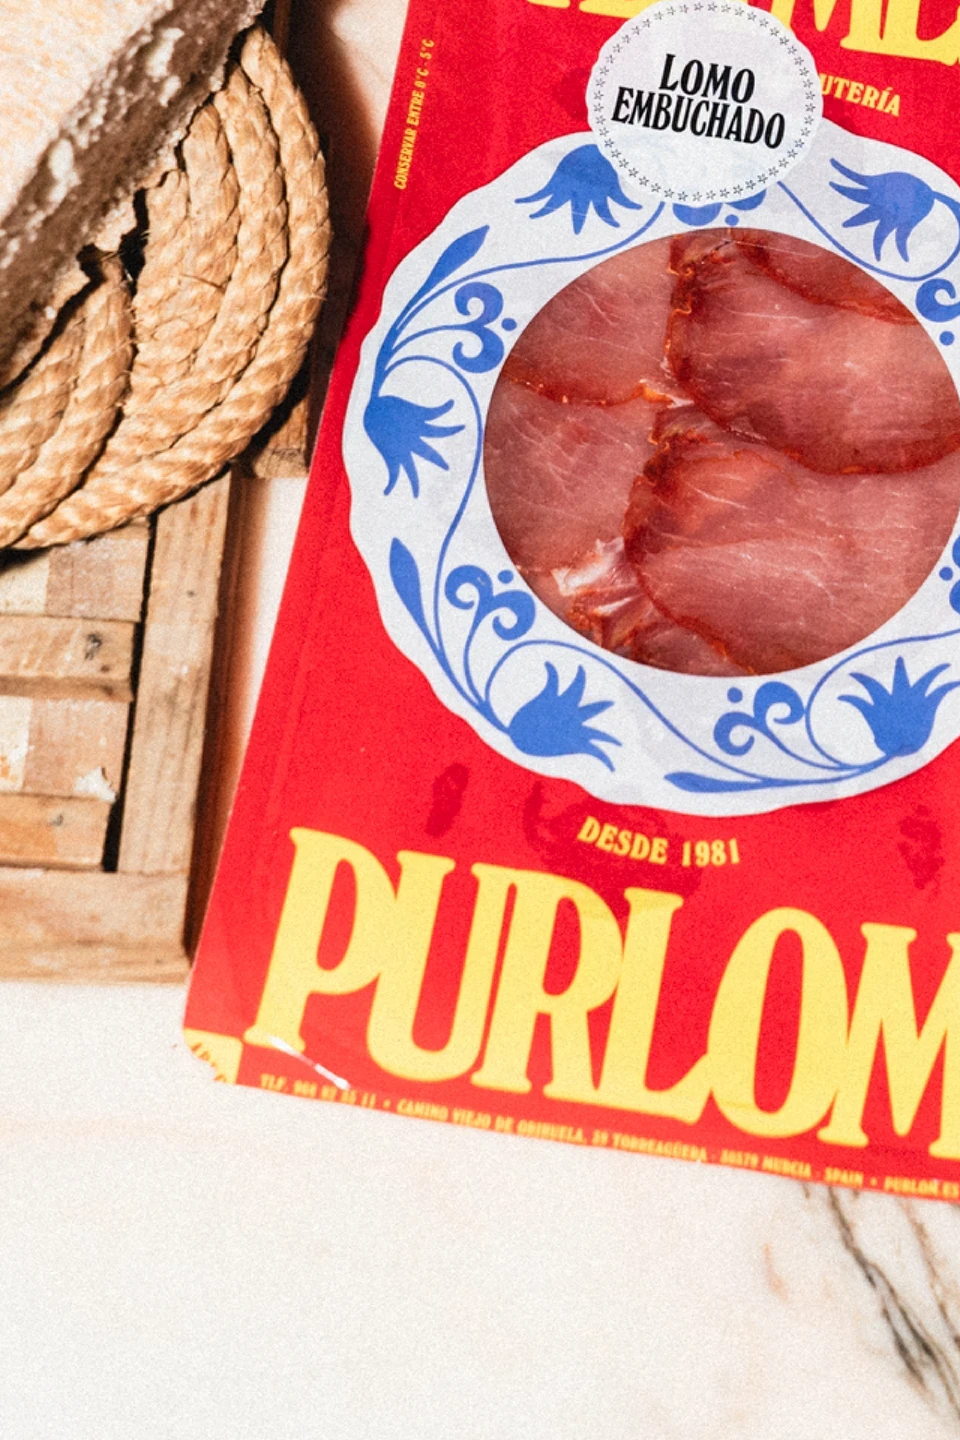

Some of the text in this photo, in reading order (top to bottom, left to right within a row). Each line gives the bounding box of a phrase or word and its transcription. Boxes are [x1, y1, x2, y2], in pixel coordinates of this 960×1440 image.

[658, 53, 756, 104] LOMO
[818, 72, 901, 117] UTERÍA
[393, 127, 418, 190] CONSERVAR
[406, 89, 425, 127] ENTRE
[611, 86, 786, 149] EMBUCHADO
[577, 815, 741, 868] DESDE 1981
[396, 1098, 449, 1123] CAMINO
[452, 1108, 492, 1130] VIEJO
[494, 1115, 514, 1134] DE
[762, 1154, 812, 1179] MURCIA
[824, 1166, 864, 1188] SPAIN
